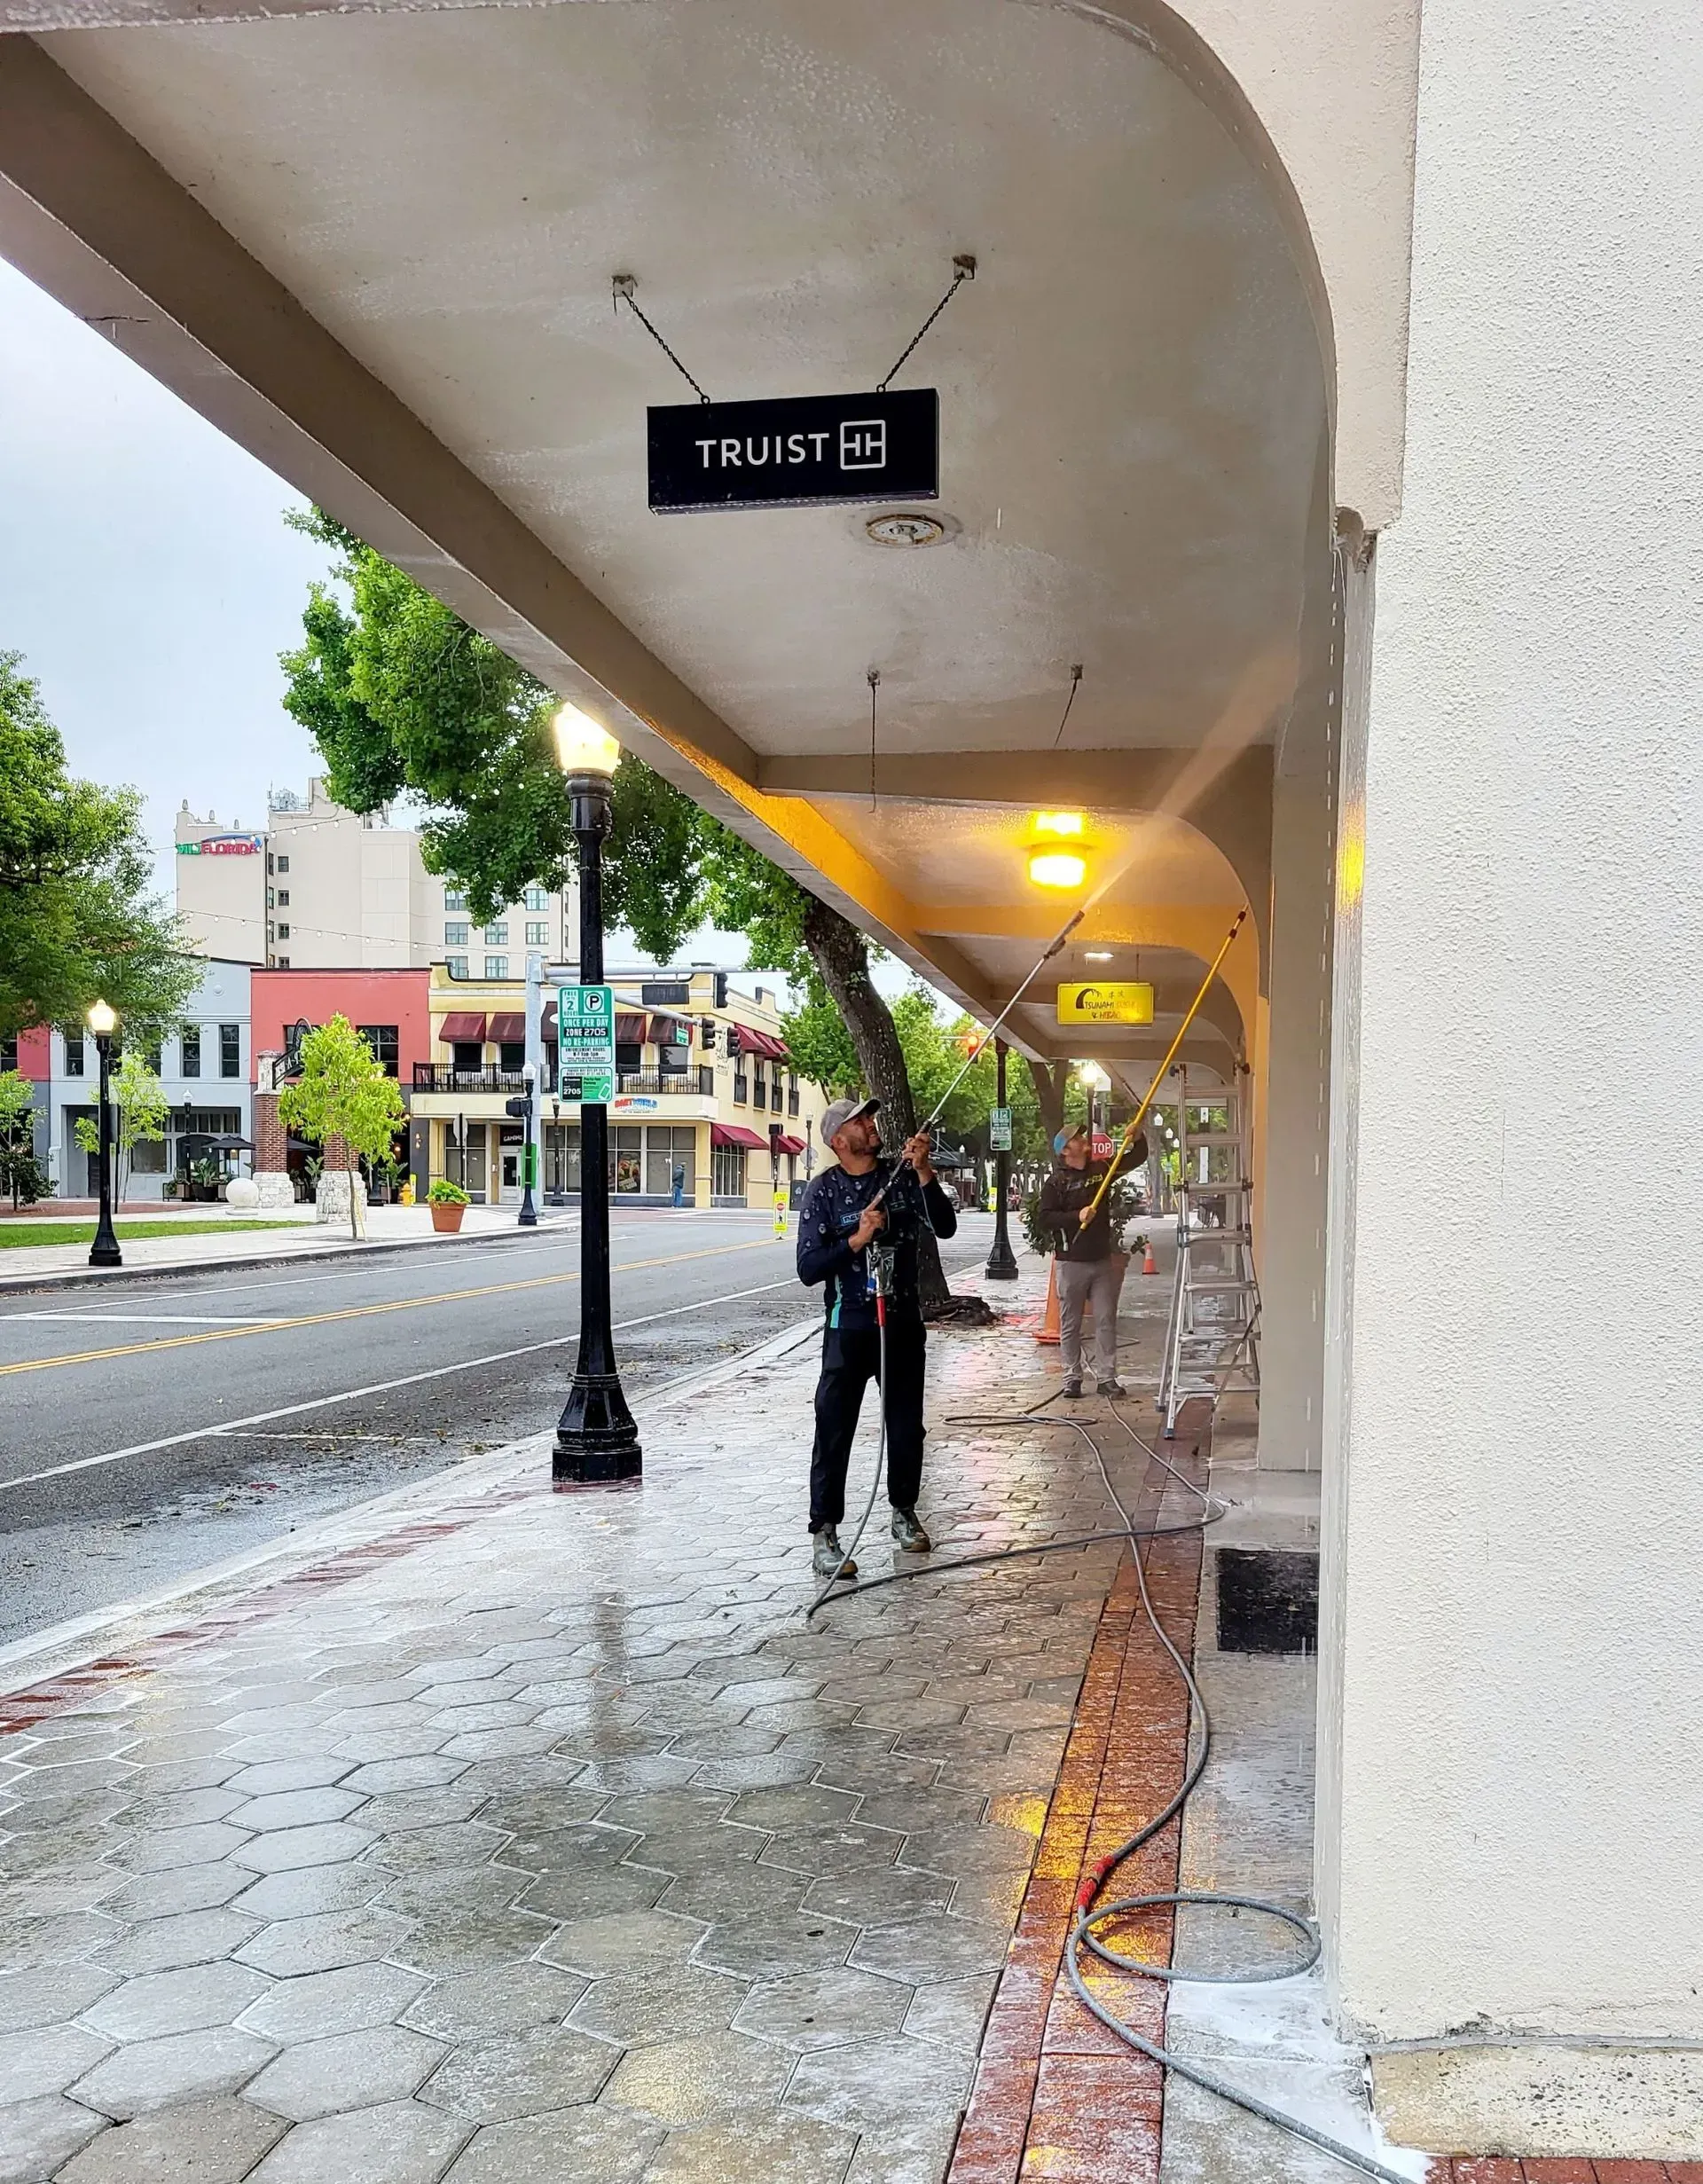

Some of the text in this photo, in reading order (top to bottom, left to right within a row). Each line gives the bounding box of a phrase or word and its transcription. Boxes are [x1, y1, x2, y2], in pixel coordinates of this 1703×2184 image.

[695, 433, 829, 467] TRUIST
[567, 1001, 574, 1010] 2
[590, 995, 600, 1009] P
[1092, 1143, 1111, 1153] TOP
